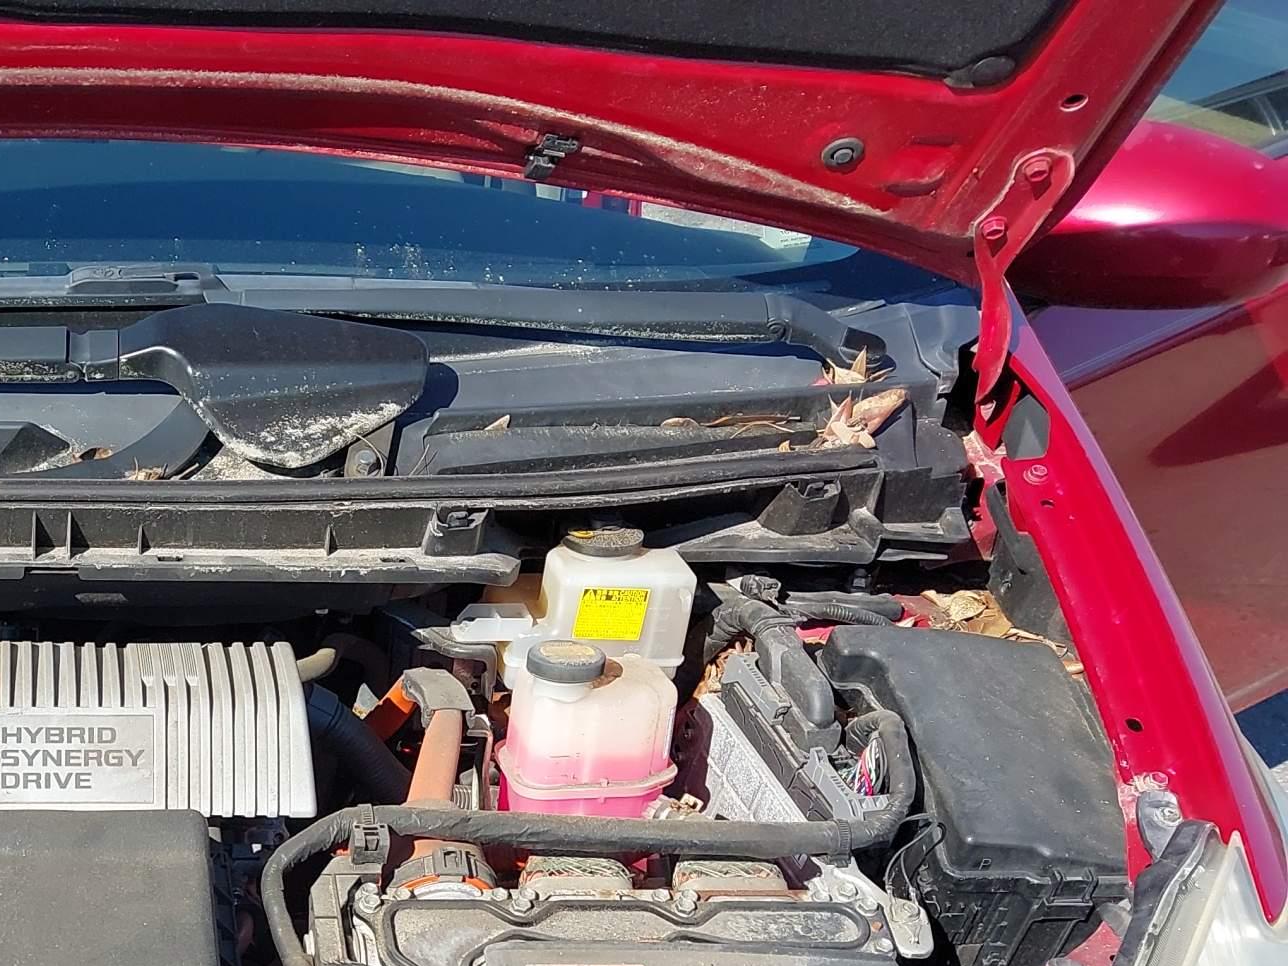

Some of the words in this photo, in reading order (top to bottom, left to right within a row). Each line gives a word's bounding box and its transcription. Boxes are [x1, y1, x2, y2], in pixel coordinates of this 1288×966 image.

[1, 726, 117, 744] HYBRID
[1, 749, 145, 767] SYNERGY
[1, 772, 93, 789] DRIVE
[978, 858, 992, 871] P
